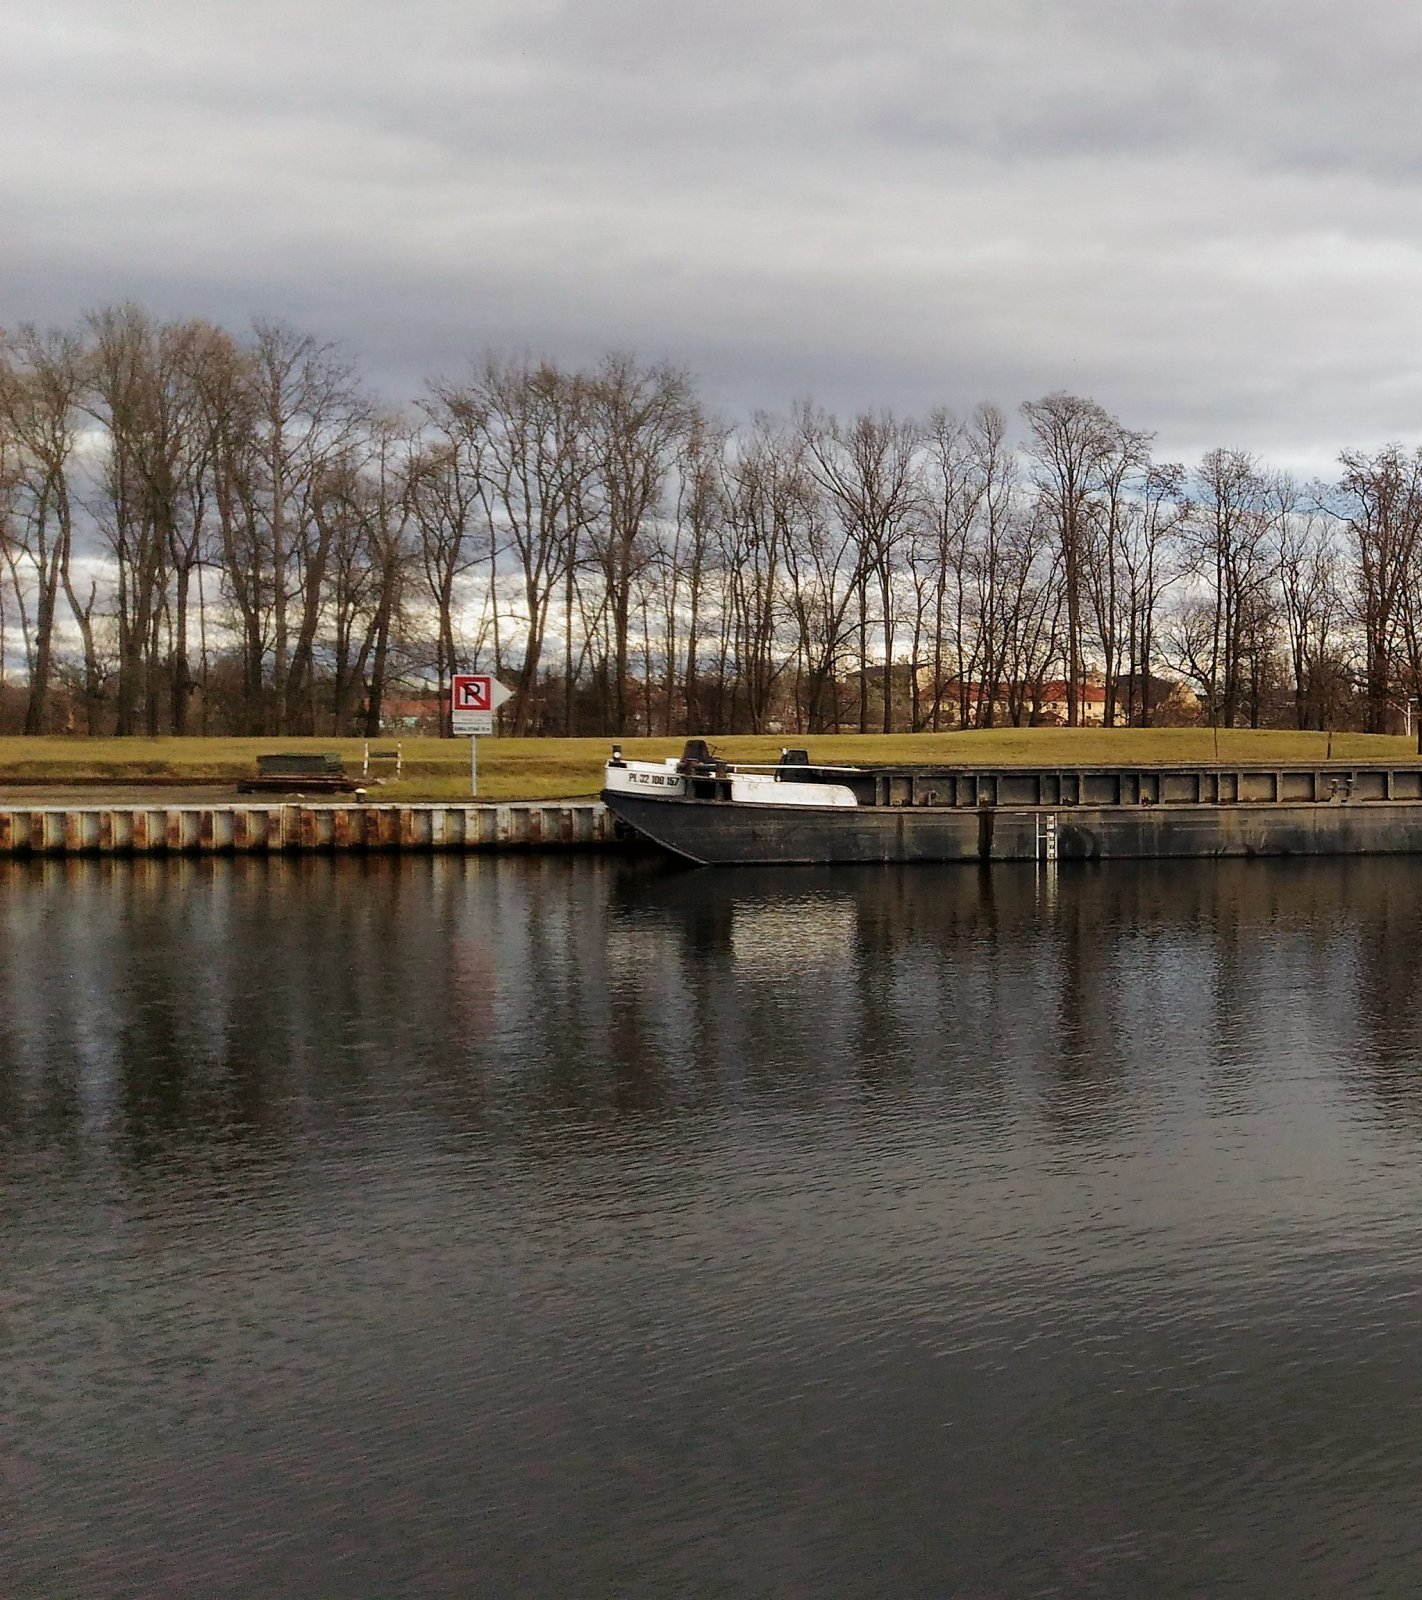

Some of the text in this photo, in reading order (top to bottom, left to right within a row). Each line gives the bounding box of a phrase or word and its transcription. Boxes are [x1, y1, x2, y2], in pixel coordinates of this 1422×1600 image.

[464, 683, 480, 704] P
[629, 773, 638, 782] PL
[640, 774, 649, 783] 32
[667, 777, 679, 786] 157
